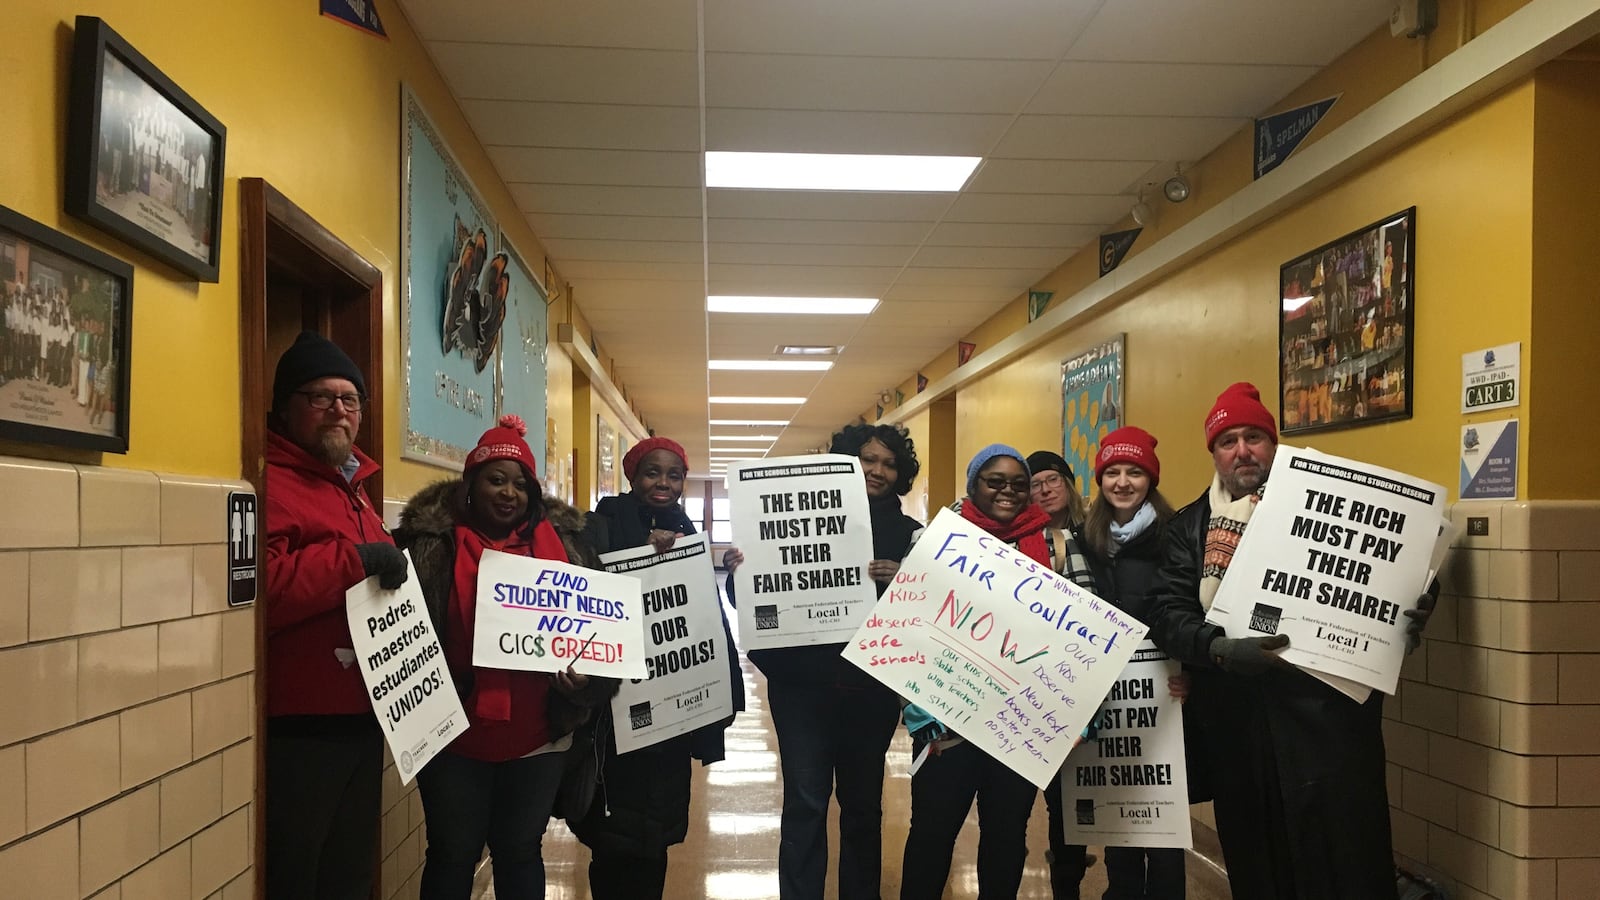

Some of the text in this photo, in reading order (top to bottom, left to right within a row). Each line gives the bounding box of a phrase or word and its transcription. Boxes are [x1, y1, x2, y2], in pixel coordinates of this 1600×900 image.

[1277, 105, 1319, 148] SPELMAN
[1490, 371, 1506, 382] IPAD
[1466, 382, 1514, 406] CART 3
[491, 447, 522, 455] TEACHERS
[742, 464, 852, 479] FOR THE SCHOOLS OUR STUDENTS DESERVE
[1294, 460, 1432, 501] FOR THE SCHOOLS OUR STUDENTS DESERVE
[760, 489, 842, 514] THE RICH
[1305, 488, 1407, 535] THE RICH
[760, 515, 847, 540] MUST PAY
[1473, 521, 1482, 531] 16
[1290, 515, 1404, 563] MUST PAY
[605, 564, 617, 573] FOR
[617, 562, 629, 571] THE
[628, 557, 652, 569] SCHOOLS
[660, 549, 687, 561] STUDENTS
[779, 543, 832, 565] THEIR
[934, 533, 995, 591] FAIR
[1306, 548, 1372, 586] THEIR
[535, 569, 588, 592] FUND
[753, 566, 861, 594] FAIR SHARE!
[493, 583, 630, 621] STUDENT NEEDS.
[642, 583, 688, 616] FUND
[889, 588, 927, 604] KIDS
[1261, 568, 1400, 626] FAIR SHARE!
[367, 599, 416, 638] Padres,
[537, 615, 592, 634] NOT
[756, 620, 778, 629] UNION
[808, 606, 849, 619] Local 1
[866, 613, 923, 628] deserve
[651, 616, 689, 646] OUR
[1250, 620, 1277, 633] UNION
[1302, 616, 1327, 626] American
[1329, 622, 1358, 635] Federation
[1367, 634, 1390, 646] Teachers
[368, 620, 429, 671] maestros,
[499, 632, 623, 664] CIC$ GREED!
[858, 634, 903, 650] safe
[1316, 626, 1369, 652] Local 1
[1327, 643, 1355, 655] AFL-CIO
[630, 638, 715, 684] CHOOLS!
[869, 651, 926, 666] schools
[1064, 643, 1097, 671] OUR
[372, 641, 439, 701] estudiantes
[386, 667, 444, 732] ¡UNIDOS!
[676, 688, 710, 709] Local 1
[1111, 678, 1154, 701] RICH
[631, 718, 652, 729] UNION
[996, 709, 1022, 735] better
[1004, 696, 1055, 744] books and
[1127, 706, 1159, 728] PAY
[437, 722, 450, 737] Local
[1098, 736, 1142, 758] THEIR
[1076, 764, 1172, 786] FAIR SHARE!
[1120, 806, 1160, 818] Local 1
